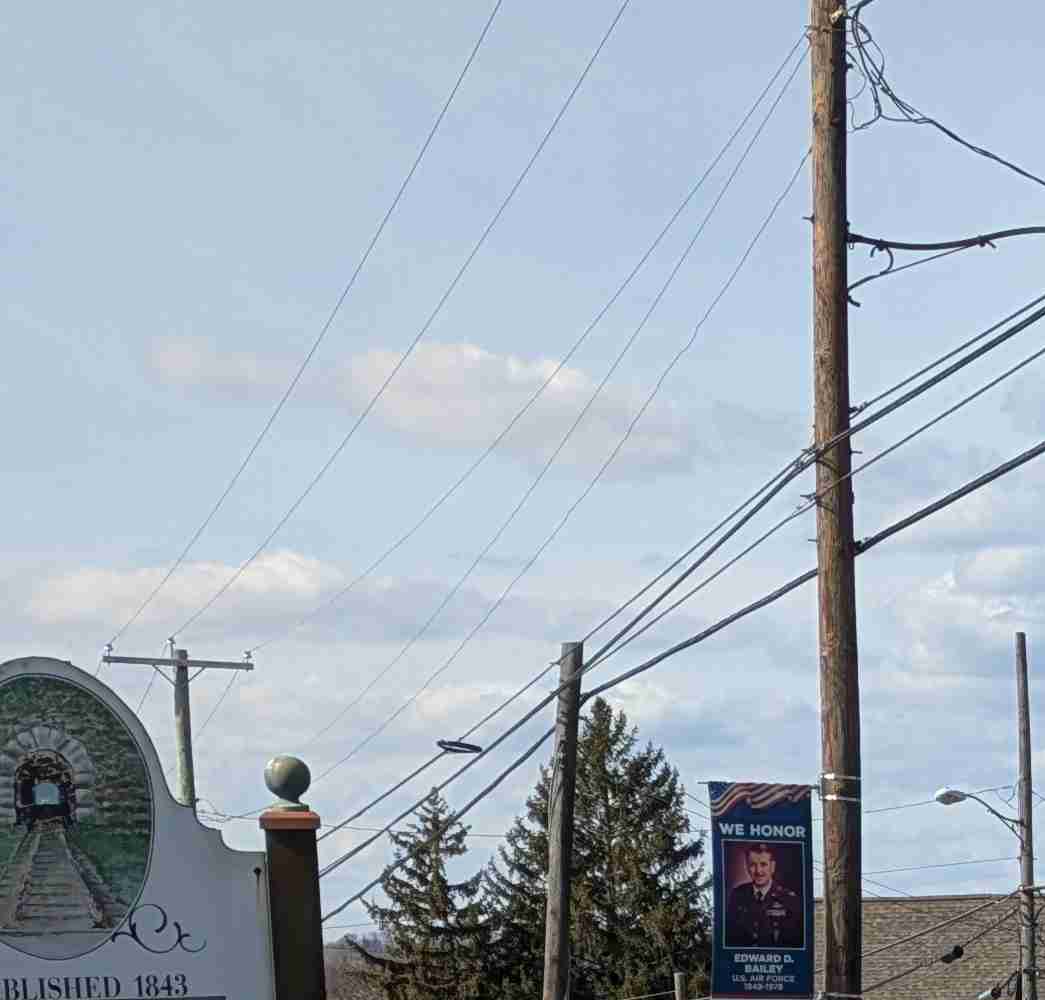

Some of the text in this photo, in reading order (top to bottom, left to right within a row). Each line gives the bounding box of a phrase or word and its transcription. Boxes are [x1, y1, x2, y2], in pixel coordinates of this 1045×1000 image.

[719, 823, 806, 838] WE HONOR
[734, 953, 794, 964] EDWARD D.
[744, 963, 784, 973] BAILEY
[749, 974, 765, 983] AIR
[766, 974, 795, 983] FORCE
[0, 974, 189, 1000] BLISHED 1843
